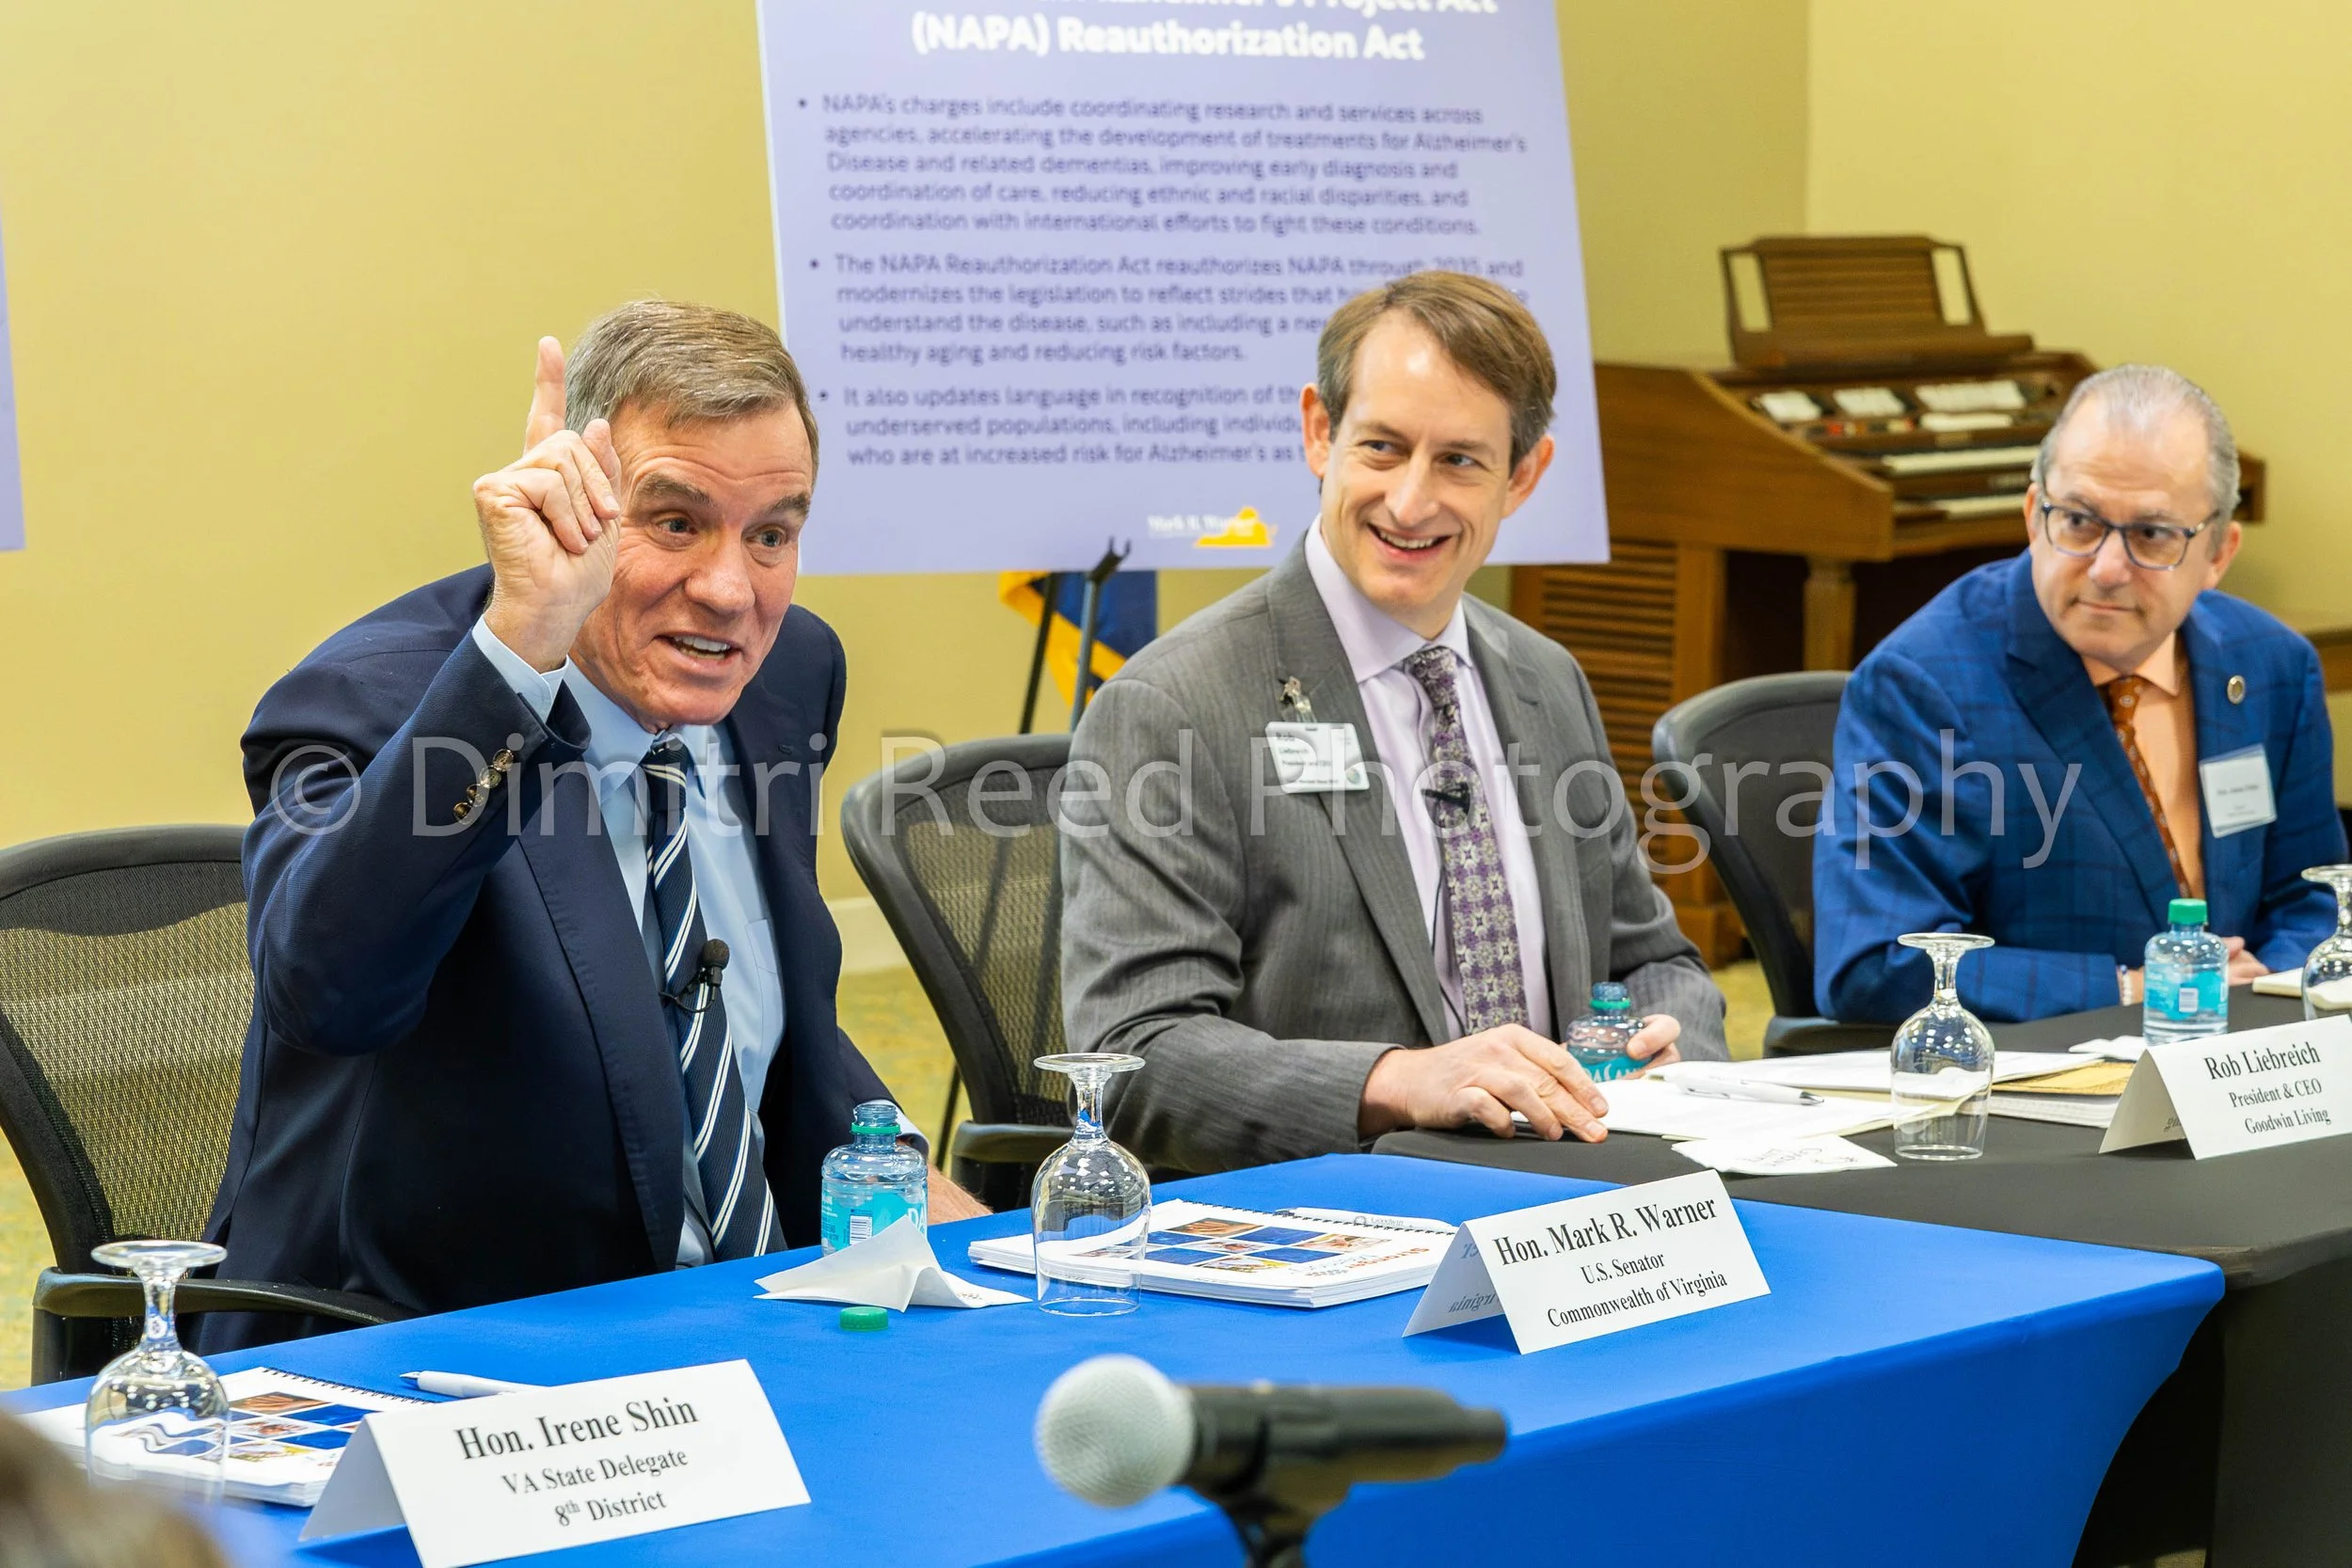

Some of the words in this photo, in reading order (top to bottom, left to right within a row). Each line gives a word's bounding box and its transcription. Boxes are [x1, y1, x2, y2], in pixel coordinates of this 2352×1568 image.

[912, 11, 1050, 56] (NAPA)
[1057, 17, 1358, 57] Reauthorization
[1363, 24, 1425, 60] Act
[900, 95, 983, 119] charges
[987, 96, 1065, 116] include
[1070, 98, 1199, 122] coordinating
[1204, 103, 1290, 119] research
[1295, 103, 1334, 121] and
[1338, 104, 1417, 122] services
[1421, 108, 1483, 123] across
[927, 126, 1055, 150] accelerating
[1058, 126, 1094, 145] the
[1098, 127, 1237, 149] development
[1240, 131, 1263, 147] of
[1266, 132, 1376, 150] treatments
[1380, 133, 1409, 150] for
[1413, 133, 1527, 153] Alzheimer's
[827, 151, 909, 172] Disease
[914, 153, 955, 172] and
[961, 153, 1036, 174] related
[1159, 158, 1263, 180] improving
[1270, 160, 1316, 180] early
[1322, 161, 1416, 182] diagnosis
[1421, 162, 1458, 179] and
[828, 183, 966, 203] coordination
[971, 182, 993, 202] of
[1052, 185, 1143, 208] reducing
[1147, 187, 1211, 204] ethnic
[1217, 188, 1255, 204] and
[1260, 188, 1314, 205] racial
[1431, 190, 1470, 207] and
[831, 213, 968, 230] coordination
[972, 213, 1020, 230] with
[1025, 213, 1159, 232] international
[1163, 214, 1230, 231] efforts
[1234, 214, 1256, 231] to
[1261, 214, 1307, 236] fight
[1311, 215, 1365, 232] these
[835, 254, 874, 274] The
[881, 254, 940, 274] NAPA
[945, 254, 1112, 275] Reauthorization
[1117, 256, 1152, 275] Act
[1156, 256, 1281, 277] reauthorizes
[1288, 257, 1343, 277] NAPA
[1486, 259, 1523, 277] and
[836, 284, 963, 304] modernizes
[967, 285, 1005, 303] the
[1009, 285, 1117, 308] legislation
[1121, 285, 1143, 304] to
[1148, 284, 1216, 304] reflect
[1220, 286, 1286, 305] strides
[1292, 285, 1333, 305] that
[838, 313, 963, 332] understand
[967, 313, 1003, 332] the
[1097, 313, 1145, 331] such
[1151, 316, 1171, 331] as
[1178, 315, 1273, 337] including
[1277, 318, 1288, 331] a
[840, 342, 921, 367] healthy
[927, 344, 984, 367] aging
[990, 342, 1028, 361] and
[1035, 343, 1128, 366] reducing
[1131, 344, 1167, 361] risk
[844, 387, 859, 405] It
[865, 387, 909, 405] also
[914, 387, 1000, 408] updates
[1005, 387, 1100, 410] language
[1105, 388, 1127, 404] in
[1131, 386, 1248, 408] recognition
[1253, 385, 1275, 404] of
[847, 415, 980, 436] underserved
[1122, 414, 1217, 436] including
[849, 445, 895, 465] who
[900, 449, 932, 465] are
[940, 447, 959, 465] at
[965, 445, 1068, 464] increased
[1073, 445, 1109, 463] risk
[1114, 445, 1143, 463] for
[1148, 441, 1265, 462] Alzheimer's
[1272, 447, 1293, 461] as
[2204, 1053, 2242, 1080] Rob
[2241, 1040, 2322, 1074] Liebreich
[2228, 1085, 2282, 1108] President
[2283, 1084, 2295, 1098] &
[2294, 1078, 2323, 1097] CEO
[2245, 1109, 2295, 1134] Goodwin
[2294, 1108, 2332, 1126] Living
[1492, 1235, 1548, 1266] Hon.
[1546, 1214, 1612, 1254] Mark
[1607, 1212, 1638, 1242] R.
[1635, 1196, 1718, 1233] Warner
[1581, 1261, 1613, 1285] U.S.
[1612, 1252, 1666, 1279] Senator
[1547, 1285, 1655, 1328] Commonwealth
[1656, 1280, 1672, 1302] of
[1667, 1270, 1728, 1298] Virginia
[454, 1425, 534, 1460] Hon.
[536, 1413, 623, 1449] Irene
[625, 1396, 701, 1434] Shin
[501, 1472, 542, 1495] VA
[544, 1465, 597, 1490] State
[602, 1447, 690, 1481] Delegate
[554, 1498, 582, 1528] 8th
[587, 1491, 668, 1522] District
